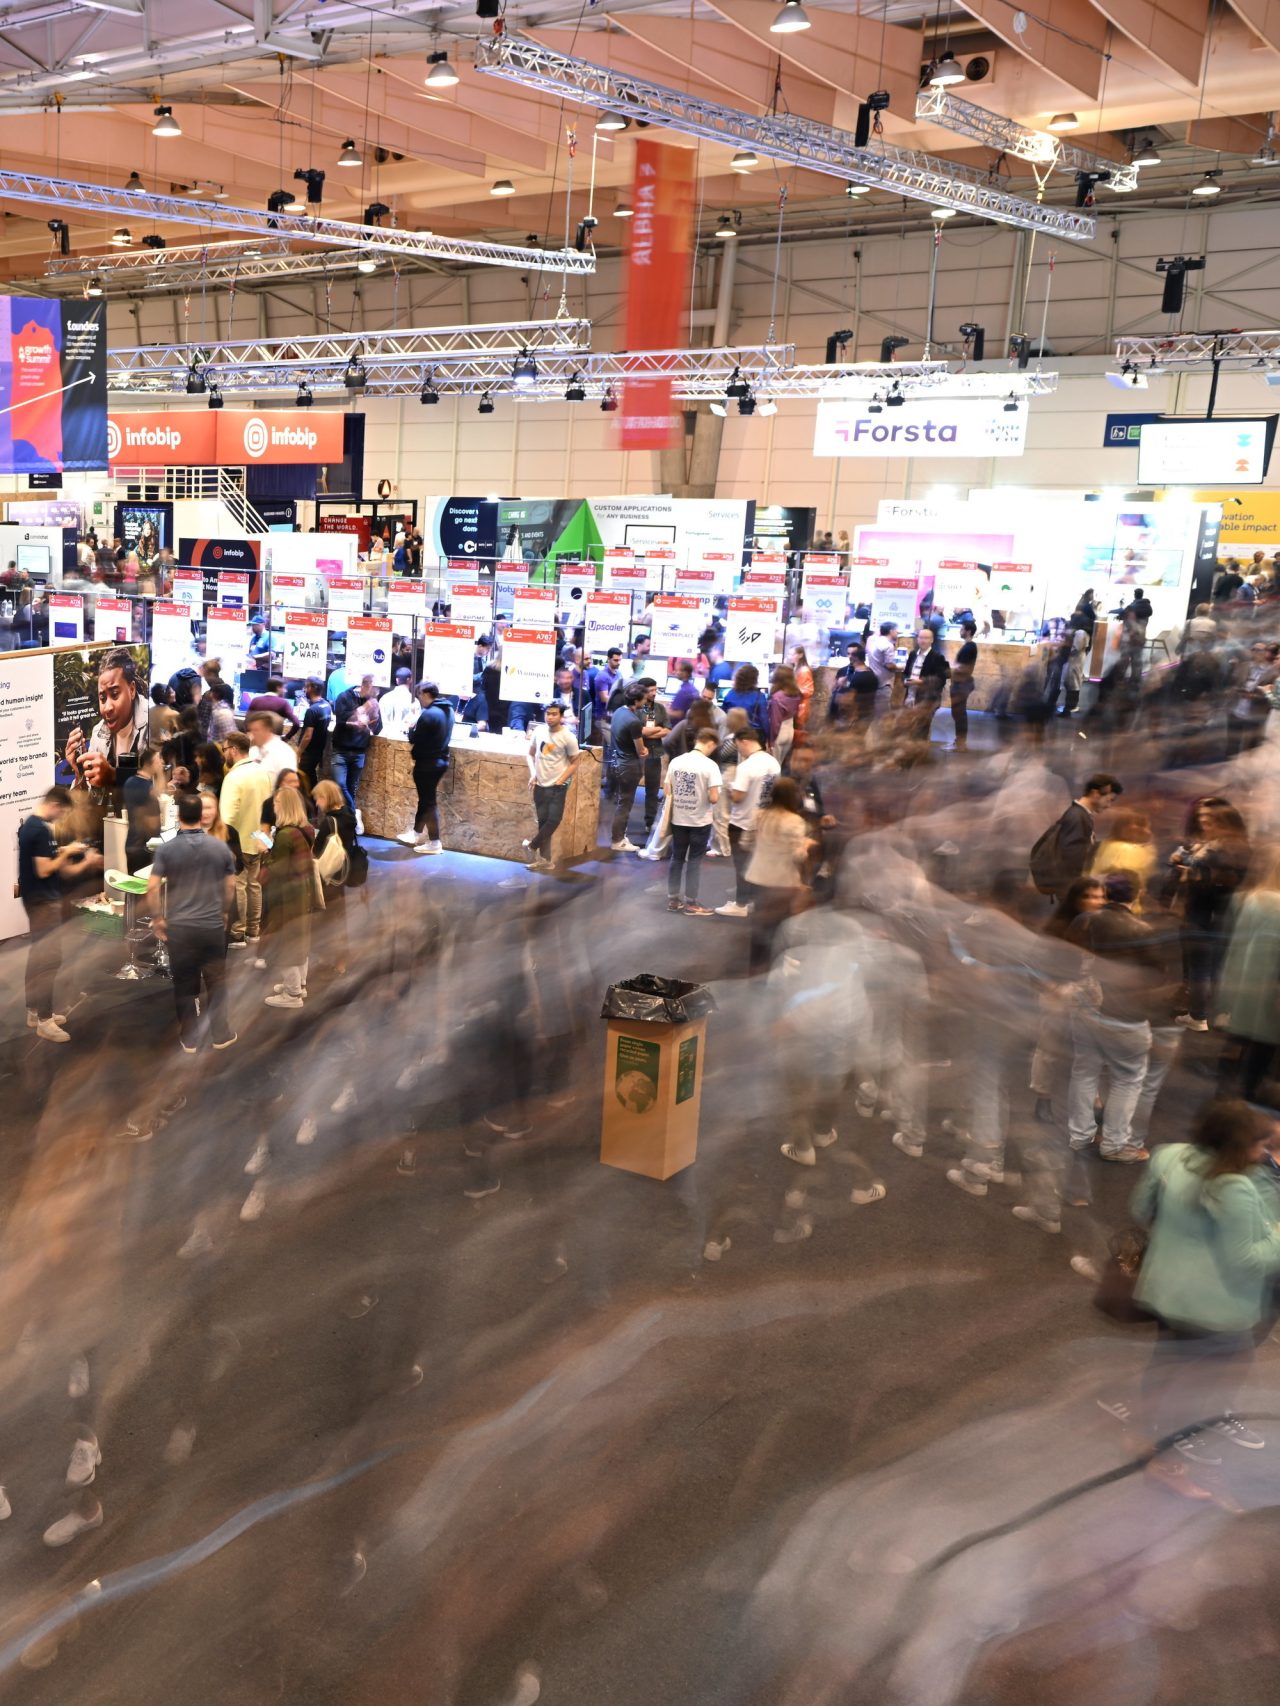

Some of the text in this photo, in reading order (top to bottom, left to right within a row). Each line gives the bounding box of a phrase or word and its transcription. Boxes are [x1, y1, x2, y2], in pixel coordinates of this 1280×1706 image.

[24, 344, 52, 357] growth
[853, 419, 958, 442] Forsta
[126, 426, 182, 450] infobip
[271, 426, 318, 450] infobip
[449, 507, 475, 515] Discover
[708, 510, 740, 519] Services
[1221, 513, 1255, 521] vation
[1242, 523, 1277, 533] impact
[223, 549, 245, 557] infobip
[587, 620, 625, 632] Upscaler
[536, 633, 553, 641] A767
[299, 642, 320, 651] DATA
[373, 653, 385, 661] hub
[5, 697, 24, 705] human
[25, 693, 44, 702] insight
[0, 756, 18, 766] world's
[19, 754, 28, 763] top
[29, 751, 48, 760] brands
[13, 789, 28, 797] team
